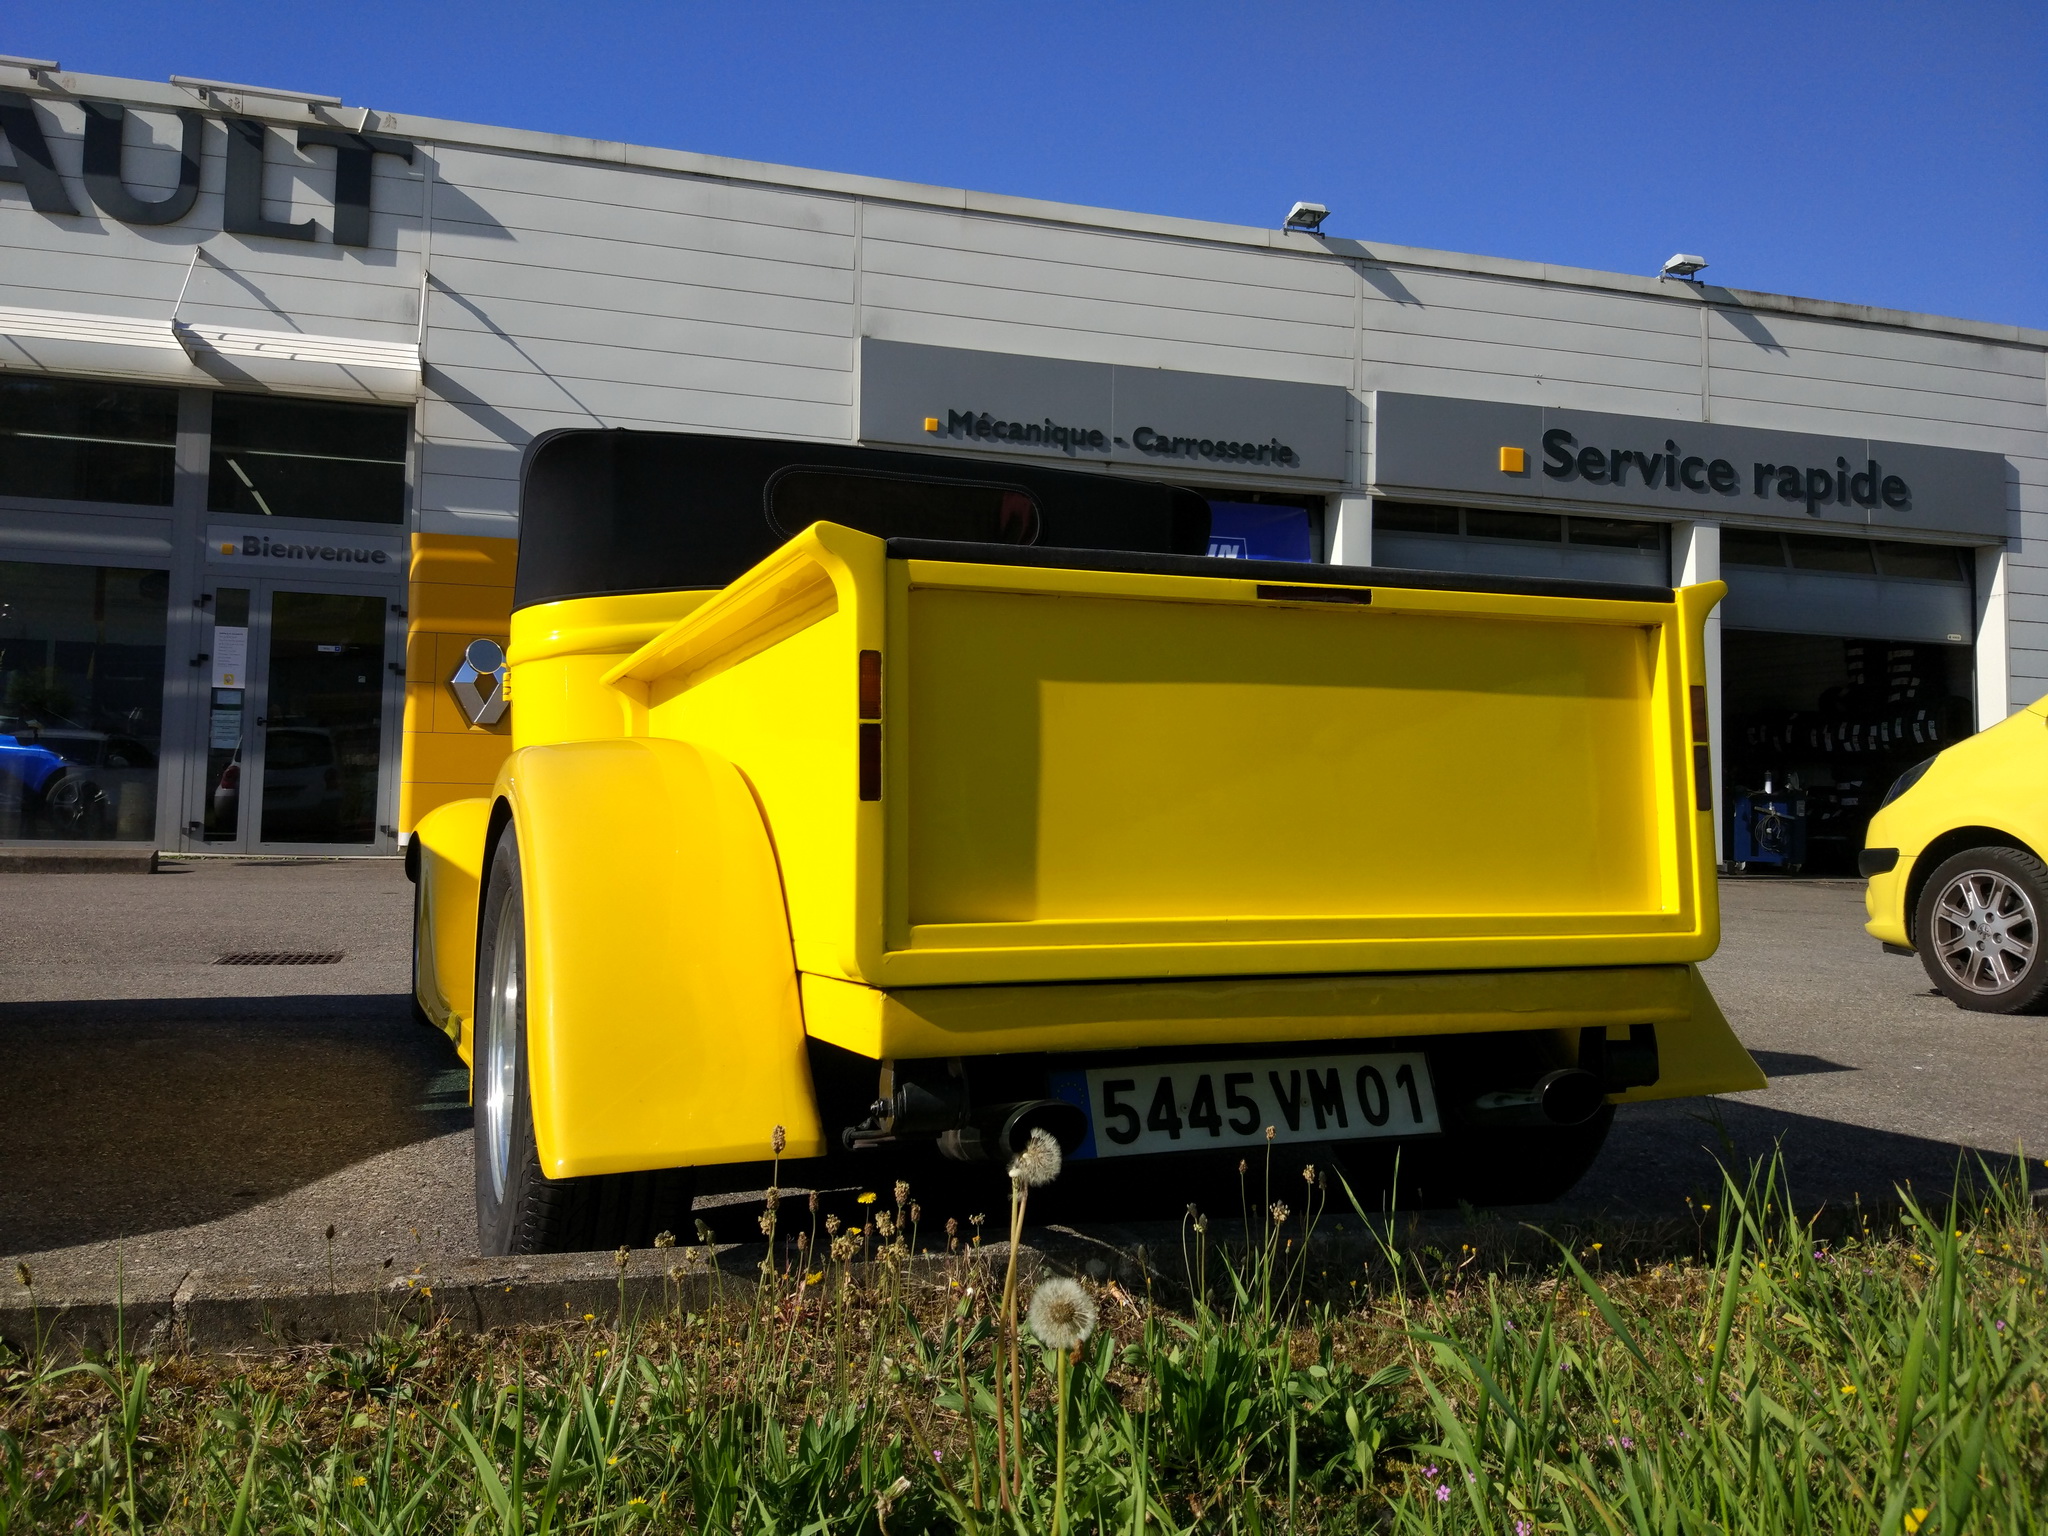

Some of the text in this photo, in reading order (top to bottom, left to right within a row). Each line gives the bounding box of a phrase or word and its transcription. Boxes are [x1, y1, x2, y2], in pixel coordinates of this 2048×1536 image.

[947, 409, 1103, 450] Mécanique
[1133, 427, 1293, 463] Carrosserie
[1542, 429, 1907, 513] Service rapide
[242, 535, 387, 564] Bienvenue
[1103, 1064, 1424, 1145] 5445 VM 01
